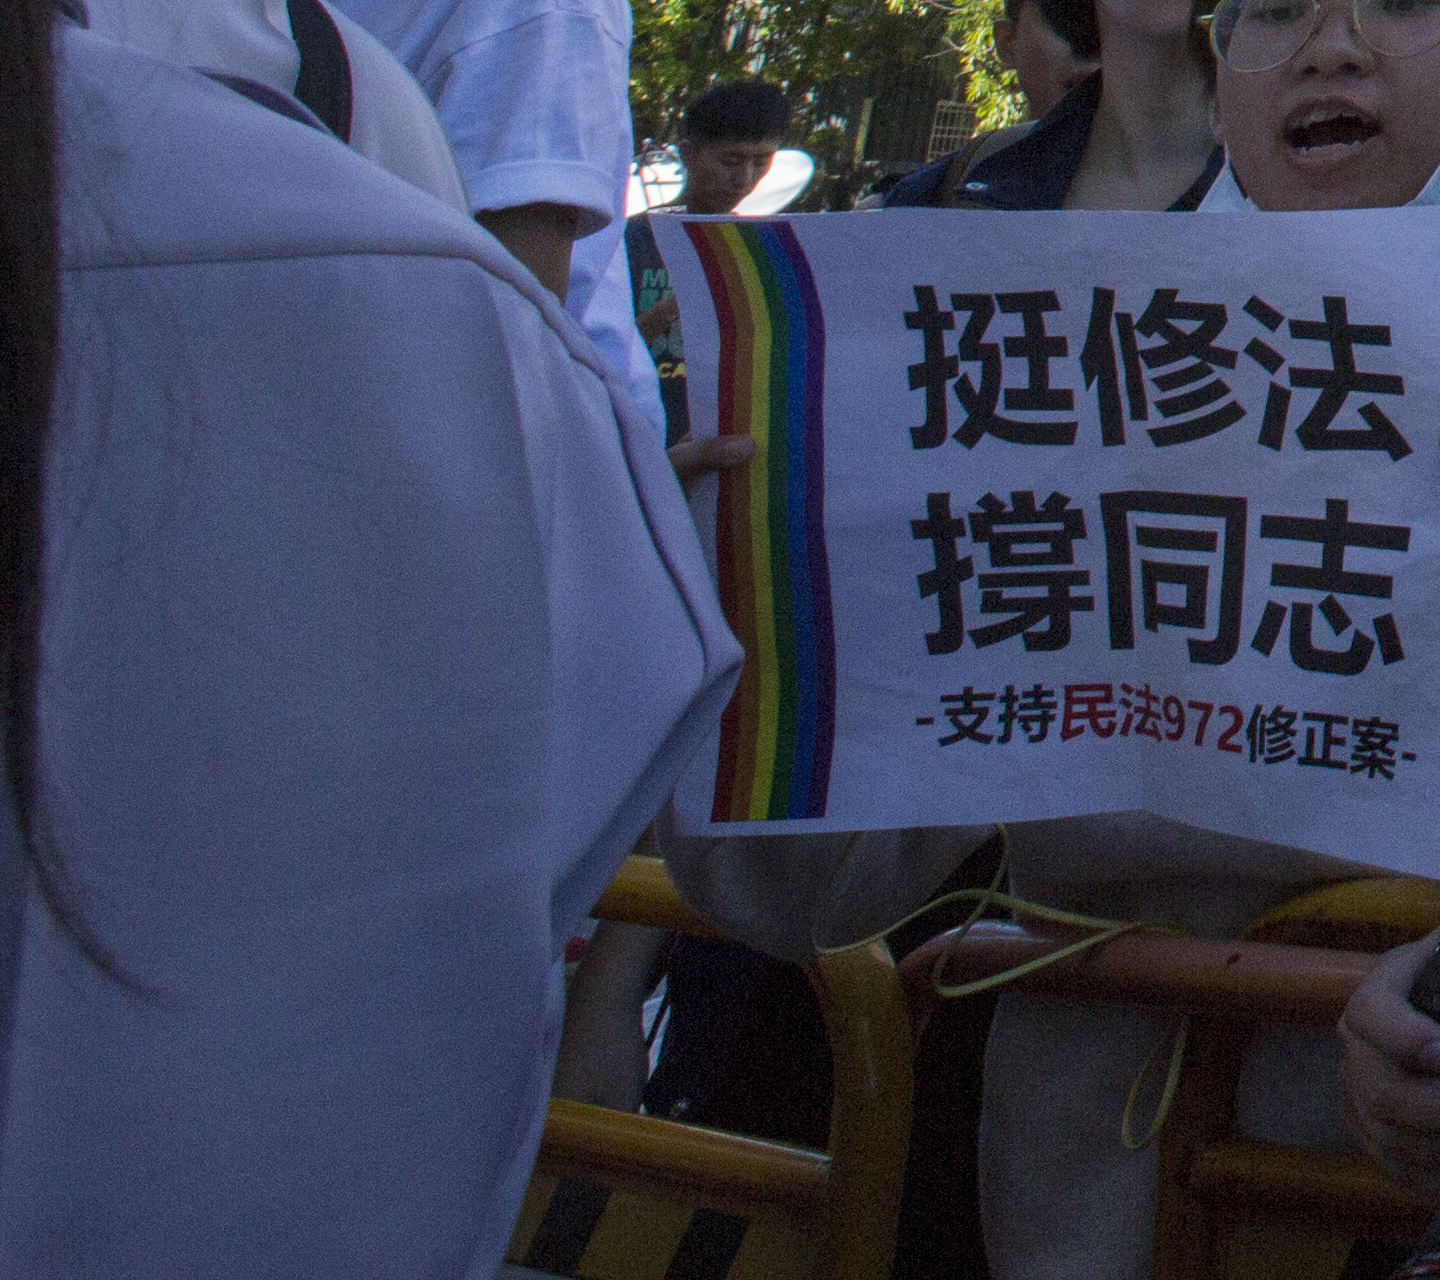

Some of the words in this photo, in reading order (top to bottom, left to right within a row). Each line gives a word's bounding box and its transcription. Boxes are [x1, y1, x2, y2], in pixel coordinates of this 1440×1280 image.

[901, 283, 1414, 463] 挺修法
[908, 489, 1412, 675] 撐同志
[914, 682, 1417, 782] -支持民法972修正案-
